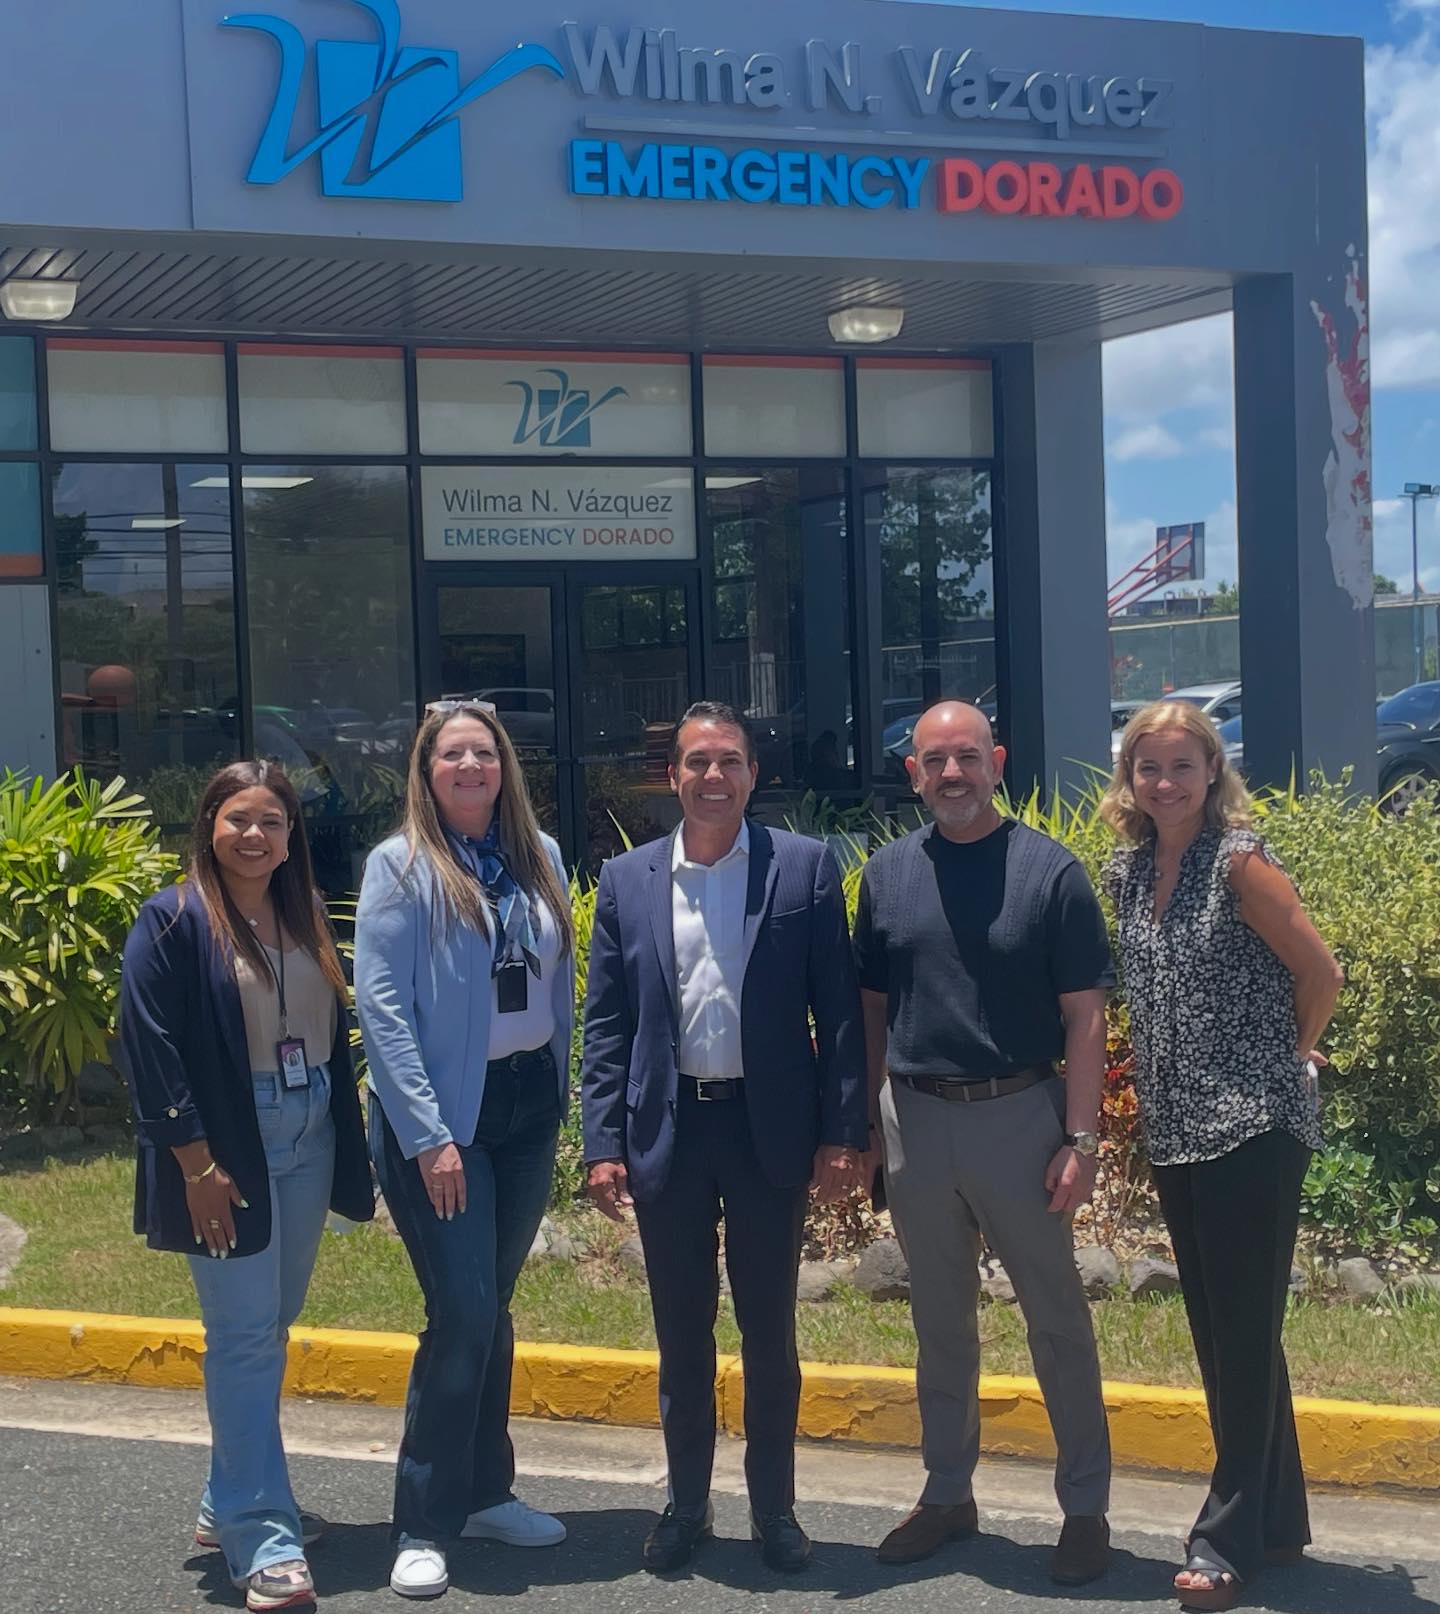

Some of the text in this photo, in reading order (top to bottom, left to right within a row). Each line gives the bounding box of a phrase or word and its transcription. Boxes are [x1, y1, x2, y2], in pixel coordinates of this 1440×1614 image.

[561, 20, 1174, 140] Wilma N. Vázquez
[569, 138, 1184, 220] EMERGENCY DORADO
[442, 487, 673, 518] Wilma N. Vázquez
[444, 527, 674, 547] EMERGENCY DORADO
